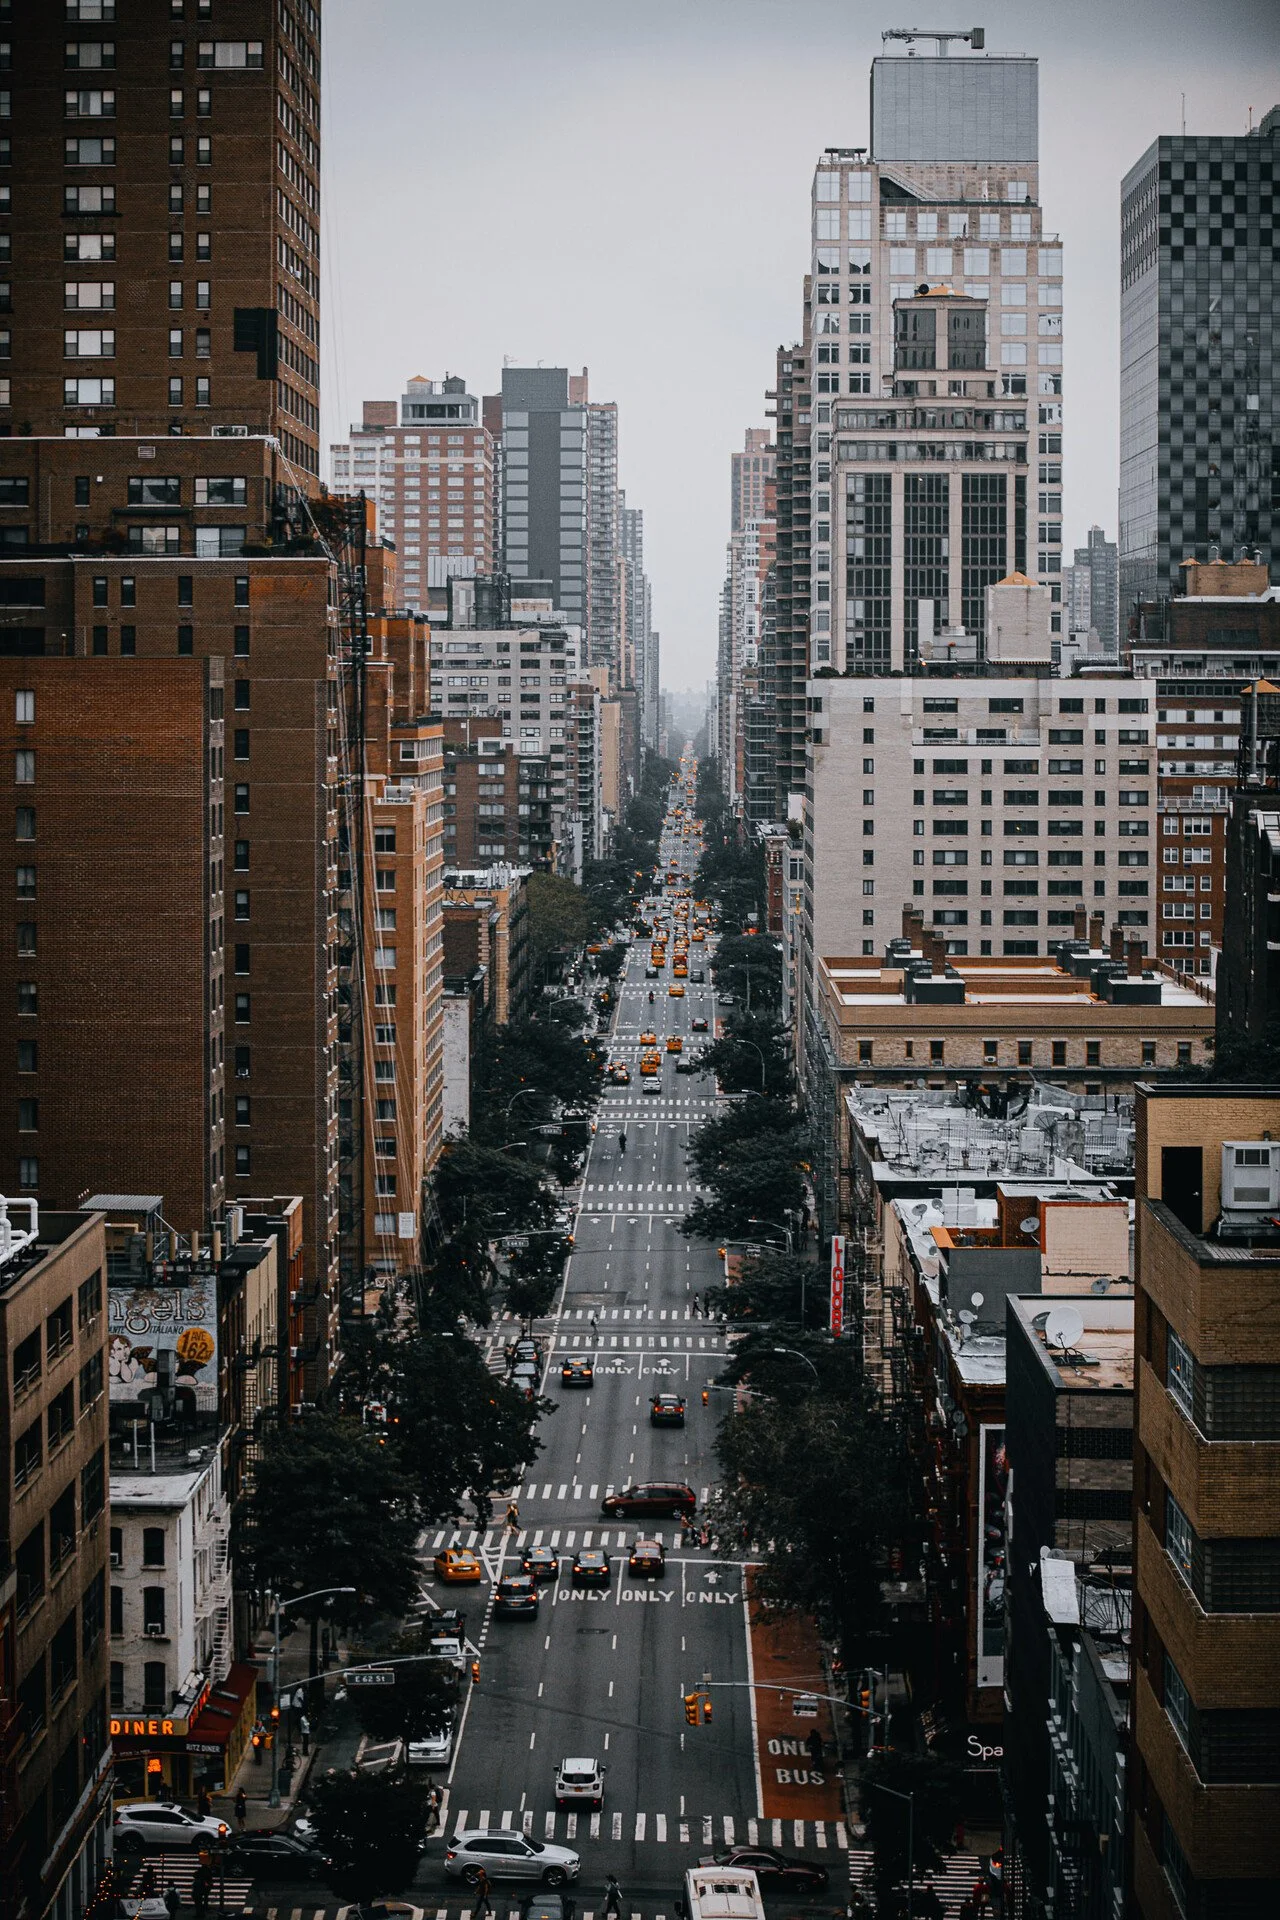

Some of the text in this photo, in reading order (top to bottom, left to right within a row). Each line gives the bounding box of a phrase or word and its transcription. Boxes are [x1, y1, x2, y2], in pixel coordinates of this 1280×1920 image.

[832, 1237, 844, 1338] LIQUORS
[149, 1325, 184, 1335] ITALIANO
[596, 1366, 635, 1374] ONLY
[642, 1367, 680, 1375] ONLY
[558, 1589, 612, 1601] ONLY
[621, 1589, 675, 1602] ONLY
[686, 1591, 740, 1604] ONLY
[110, 1719, 174, 1736] DINER
[185, 1743, 221, 1753] RITZ DINER
[768, 1738, 813, 1757] ONL
[967, 1735, 1004, 1761] Spa
[776, 1768, 825, 1785] BUS
